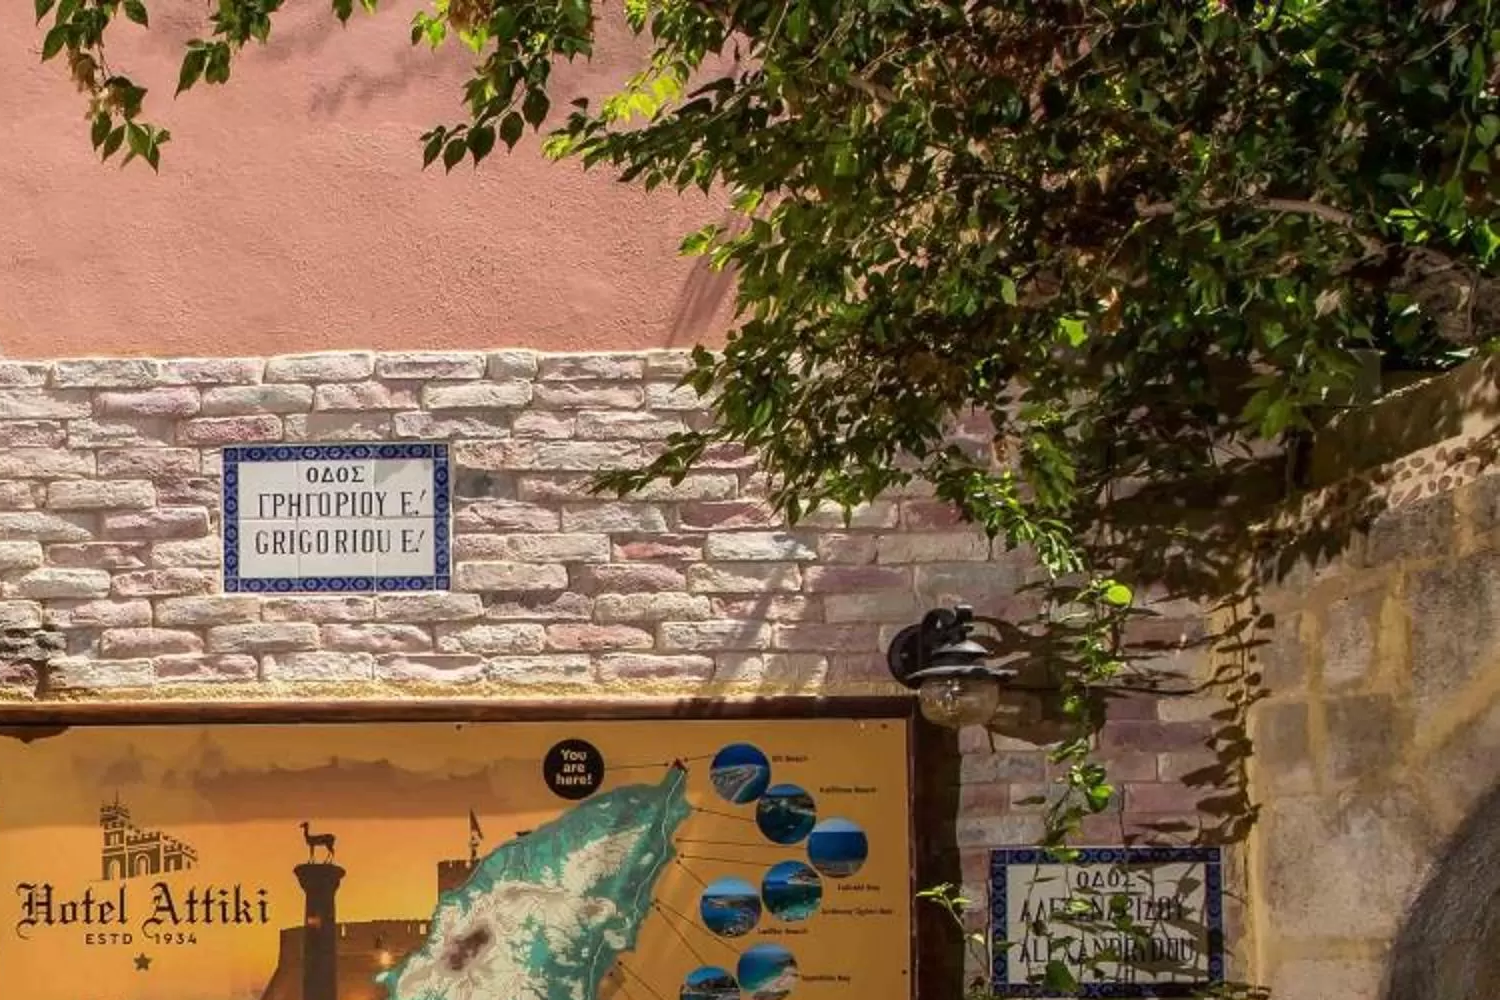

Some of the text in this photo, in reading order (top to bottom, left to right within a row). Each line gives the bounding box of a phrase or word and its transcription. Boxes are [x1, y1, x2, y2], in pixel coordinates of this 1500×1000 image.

[306, 465, 365, 483] ΟΔΟΣ
[258, 491, 387, 517] ΓΡΗΓΟΡΙΟΥ
[255, 529, 391, 554] GRIGORIOU
[560, 749, 588, 761] You
[563, 763, 585, 773] are
[555, 772, 593, 785] here!
[16, 881, 270, 940] Hotel Attiki
[85, 932, 197, 945] ESTD 1934
